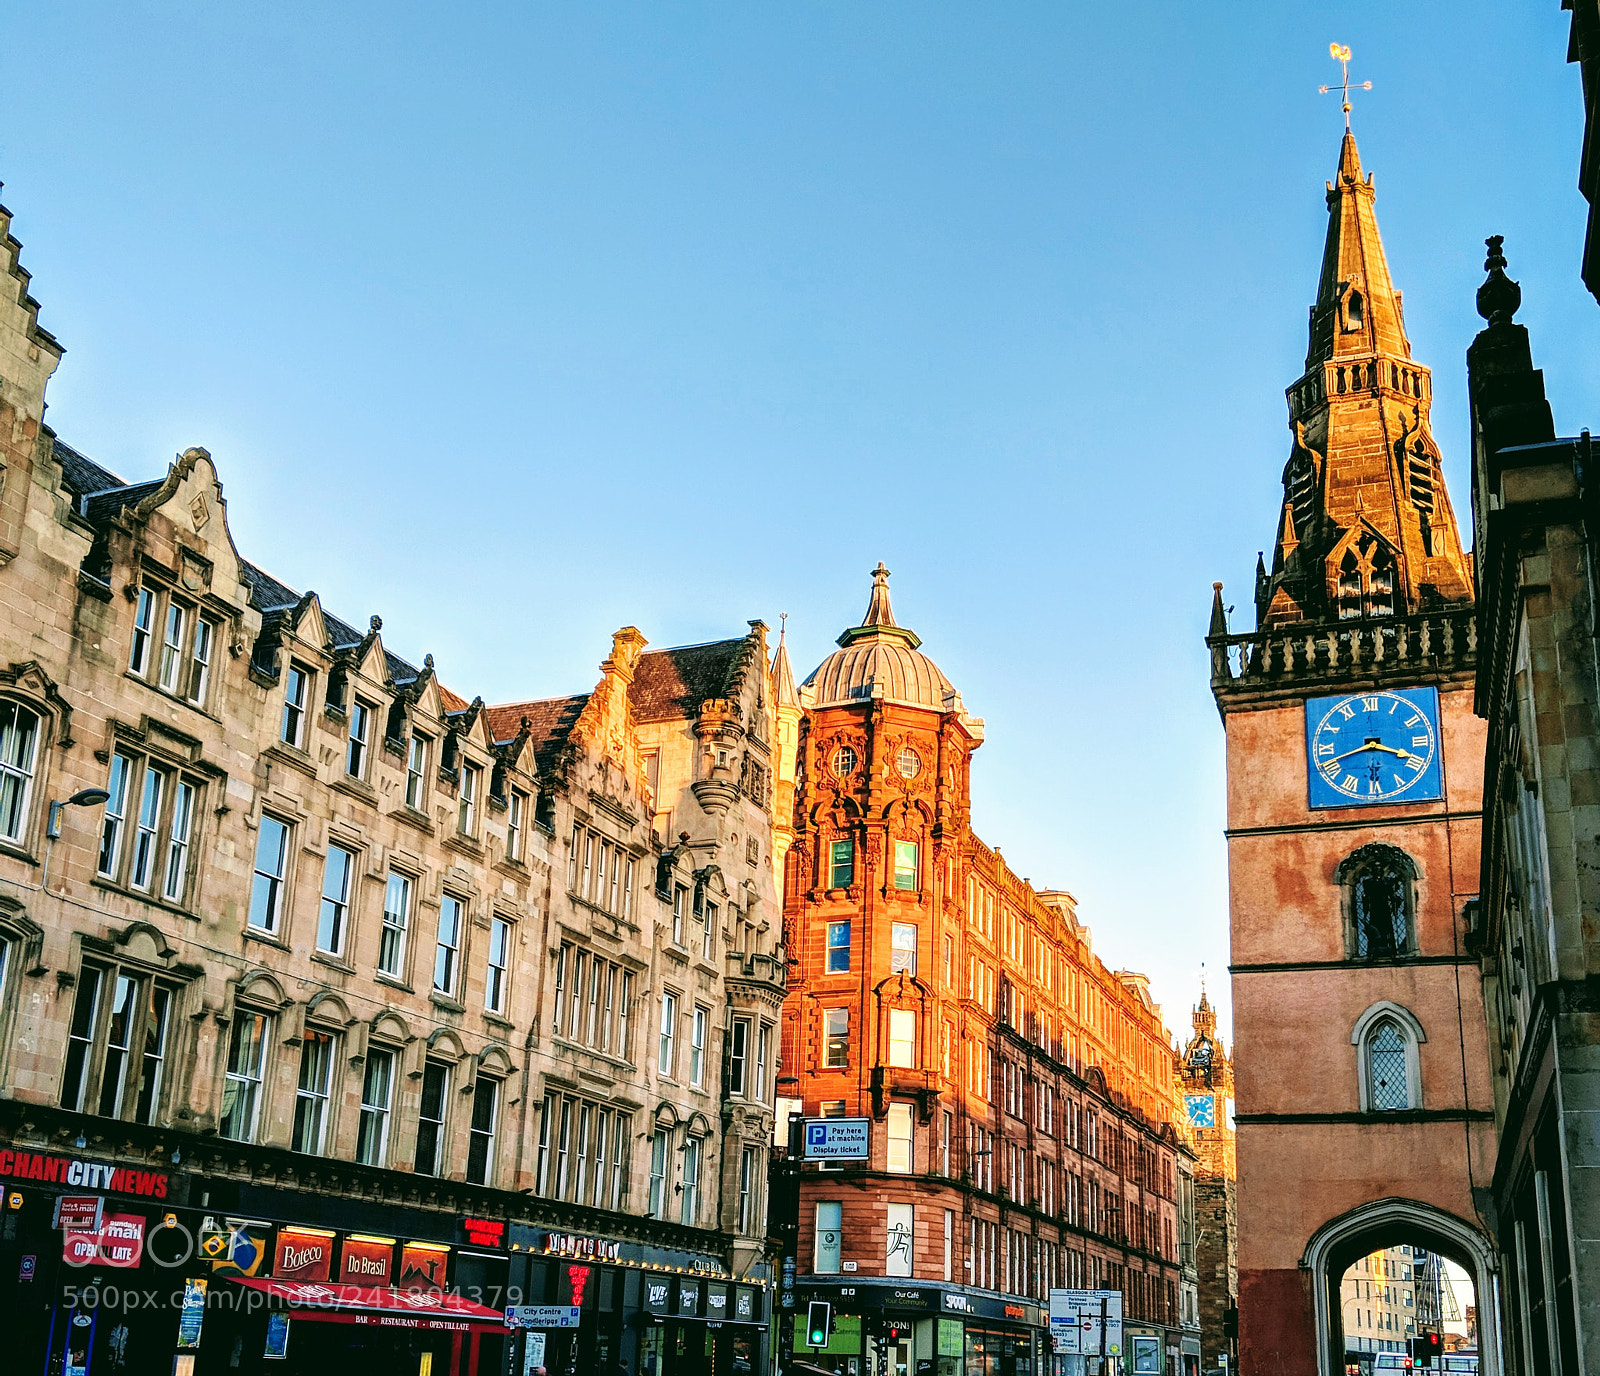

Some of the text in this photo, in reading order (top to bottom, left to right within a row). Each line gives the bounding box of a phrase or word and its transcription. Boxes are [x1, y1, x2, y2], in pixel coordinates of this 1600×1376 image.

[1338, 704, 1356, 721] XI
[1362, 698, 1378, 712] XII
[1324, 723, 1340, 734] X
[1404, 714, 1421, 728] II
[1319, 742, 1334, 755] IX
[1412, 735, 1428, 747] III
[1341, 774, 1359, 792] VII
[1369, 780, 1383, 794] VI
[1393, 773, 1406, 788] V
[108, 1224, 142, 1240] mail
[74, 1242, 97, 1257] OPEN
[112, 1246, 132, 1260] LATE
[282, 1246, 322, 1269] Boteco
[348, 1255, 386, 1276] Do Brasil
[355, 1316, 470, 1331] BAR RESTAURANT OPEN TILL LATE
